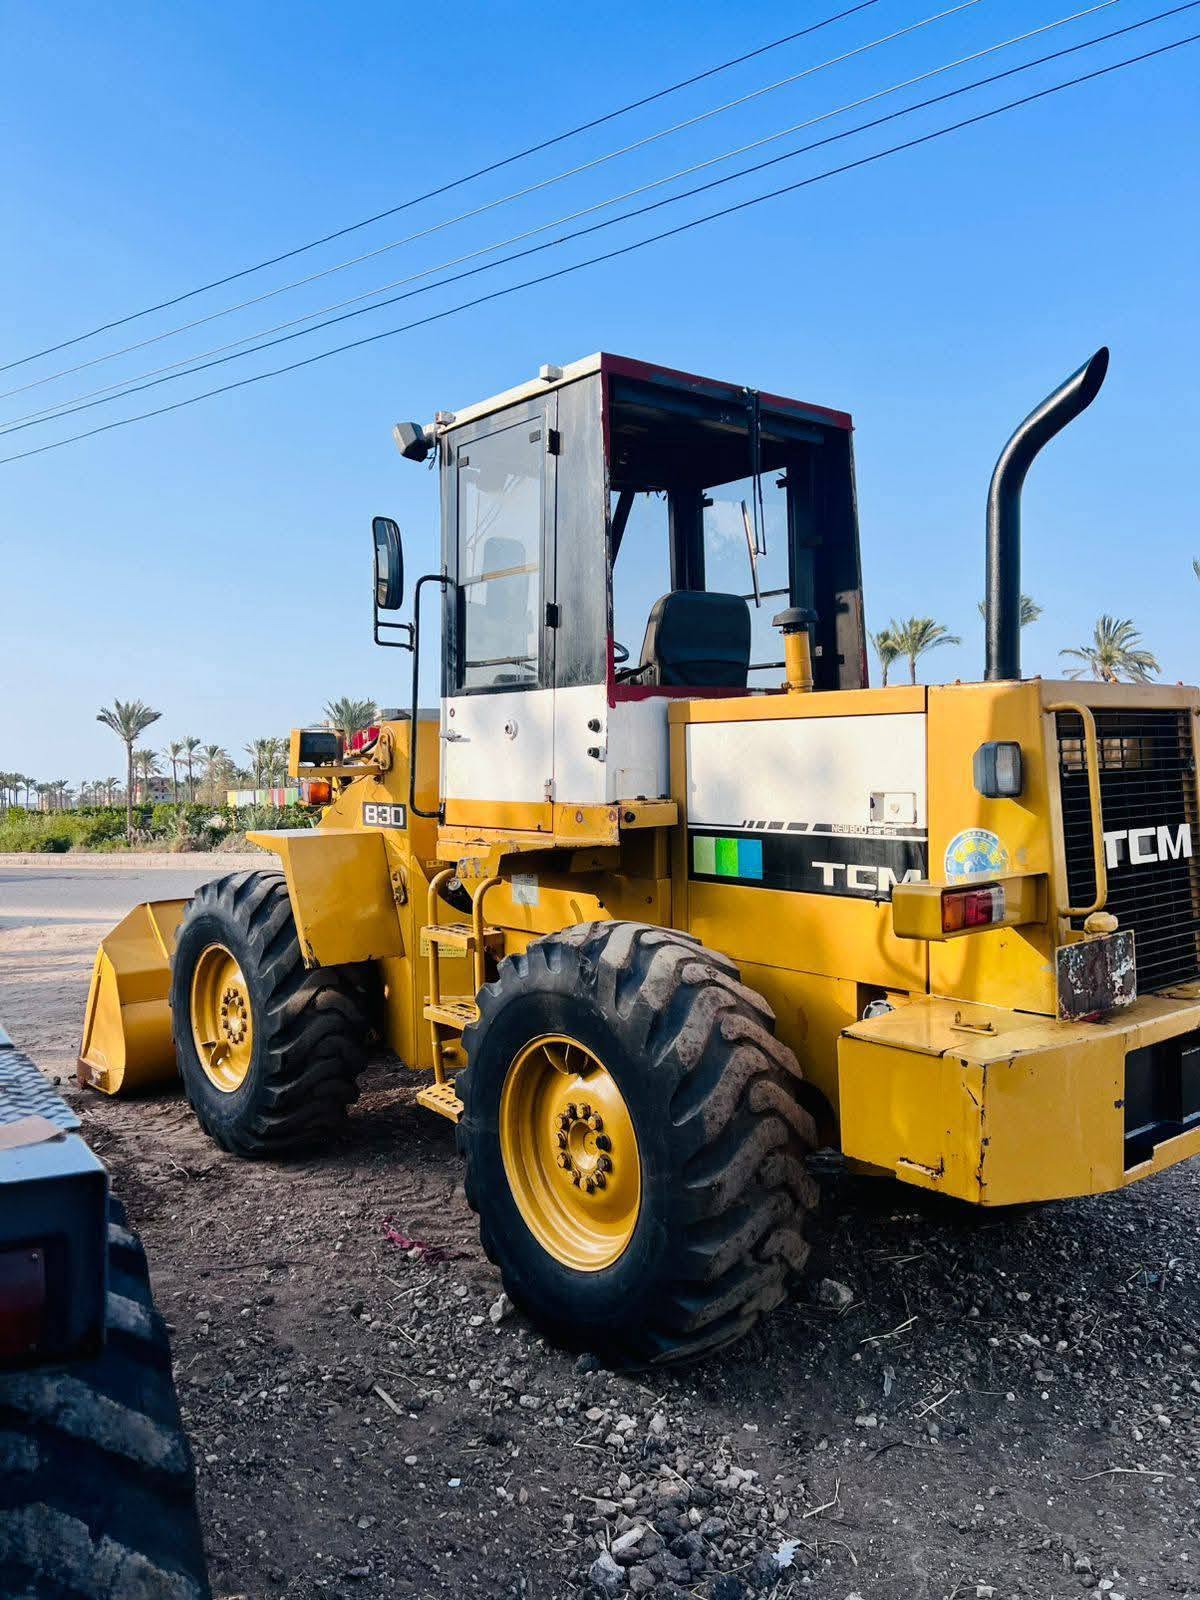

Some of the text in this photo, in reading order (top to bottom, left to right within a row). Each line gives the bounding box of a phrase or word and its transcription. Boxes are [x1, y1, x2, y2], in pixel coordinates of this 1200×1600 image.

[365, 804, 403, 826] 830
[1103, 823, 1193, 869] TCM
[811, 861, 922, 891] TCM
